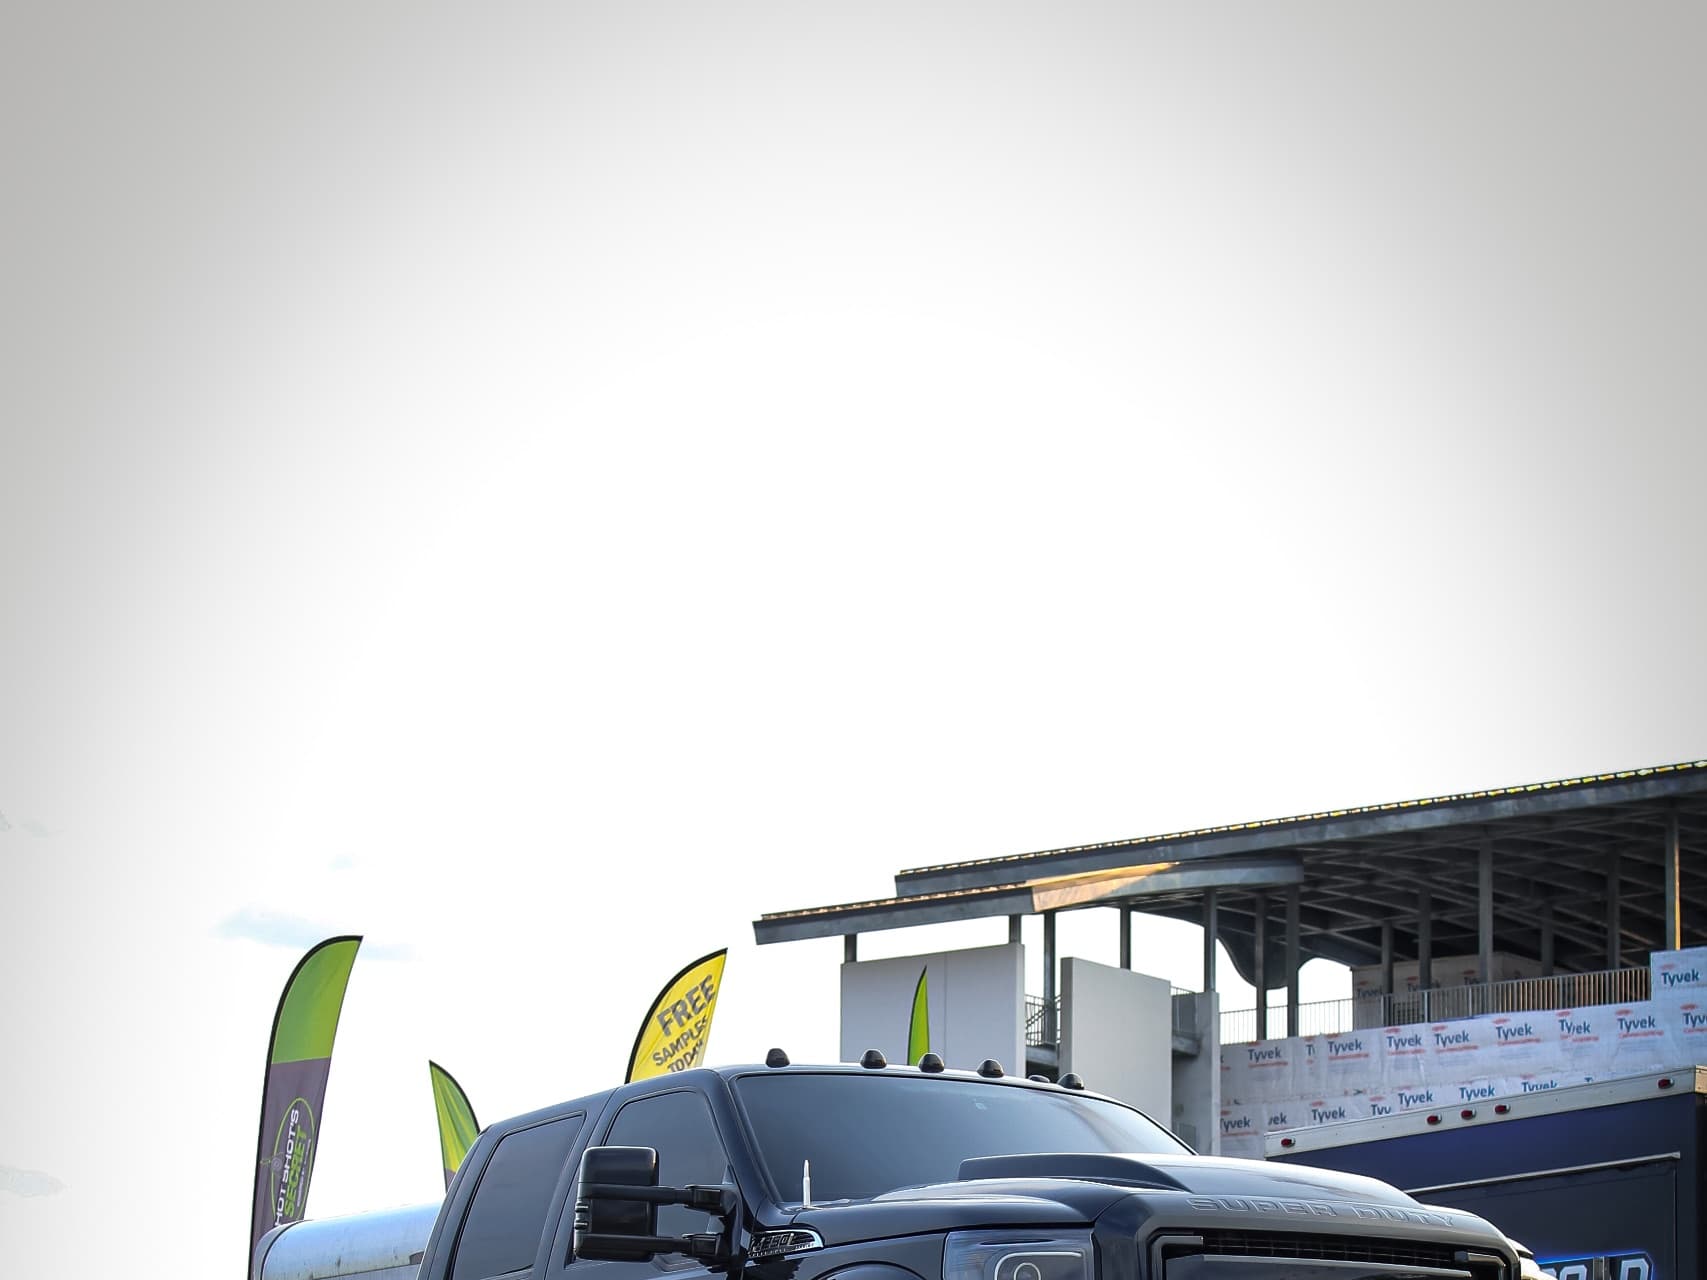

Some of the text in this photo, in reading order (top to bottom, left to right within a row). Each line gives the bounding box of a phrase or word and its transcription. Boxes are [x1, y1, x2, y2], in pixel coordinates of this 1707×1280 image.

[1662, 969, 1700, 987] Tyvek
[657, 974, 715, 1037] FREE
[1496, 1022, 1533, 1041] Tyvek
[1617, 1016, 1656, 1033] Tyvek
[1328, 1038, 1362, 1054] Tyvek
[1386, 1034, 1422, 1050] Tyvek
[1434, 1030, 1470, 1047] Tyvek
[1248, 1047, 1282, 1063] Tyvek
[1398, 1090, 1433, 1108] Tyvek
[1459, 1084, 1496, 1101] Tyvek
[1311, 1107, 1346, 1123] Tyvek
[274, 1108, 299, 1227] HOT SHOT'S
[284, 1124, 307, 1218] SECRET
[1189, 1198, 1453, 1227] SUPER DUTY
